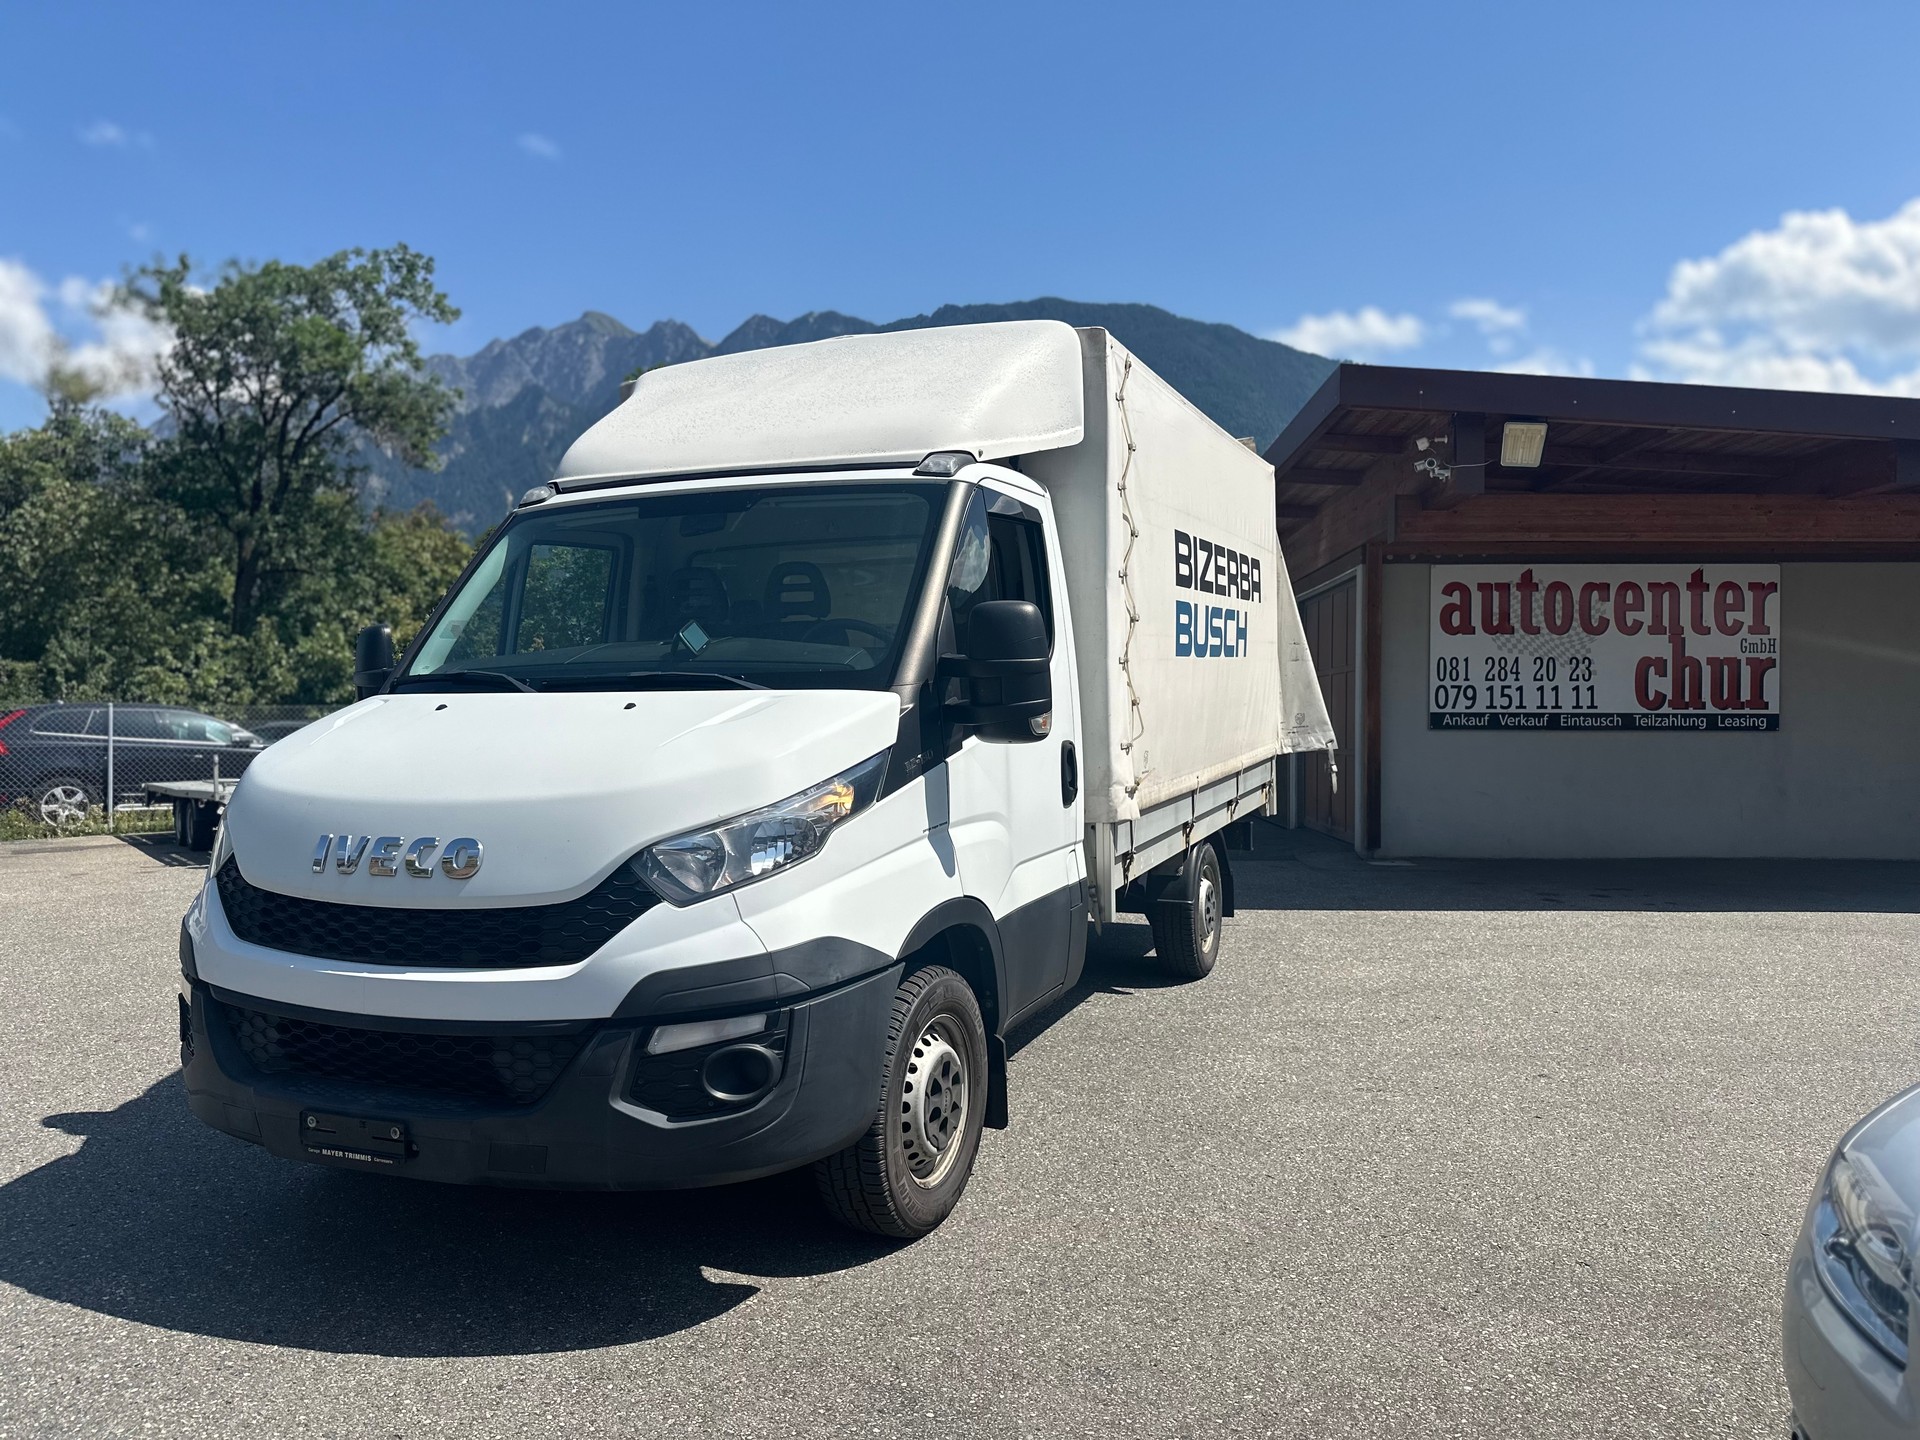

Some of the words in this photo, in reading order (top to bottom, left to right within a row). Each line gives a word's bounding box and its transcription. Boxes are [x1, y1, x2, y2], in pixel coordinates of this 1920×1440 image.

[1174, 528, 1262, 604] BIZERBA
[1439, 568, 1778, 636] autocenter
[1175, 600, 1248, 658] BUSCH
[1739, 638, 1777, 654] GmbH
[1436, 656, 1471, 682] 081
[1484, 656, 1520, 682] 284
[1533, 656, 1556, 682] 20
[1568, 656, 1593, 682] 23
[1634, 633, 1777, 711] chur
[1434, 684, 1477, 710] 079
[1485, 684, 1527, 710] 151
[1536, 684, 1562, 710] 11
[1572, 684, 1598, 710] 11
[1442, 713, 1490, 727] Ankauf
[1498, 713, 1549, 727] Verkauf
[1560, 713, 1622, 728] Eintausch
[1634, 714, 1707, 730] Teilzahlung
[1717, 714, 1767, 730] Leasing
[312, 833, 484, 879] IVECO
[322, 1148, 344, 1158] MAYER
[344, 1151, 372, 1162] TRIMMIS
